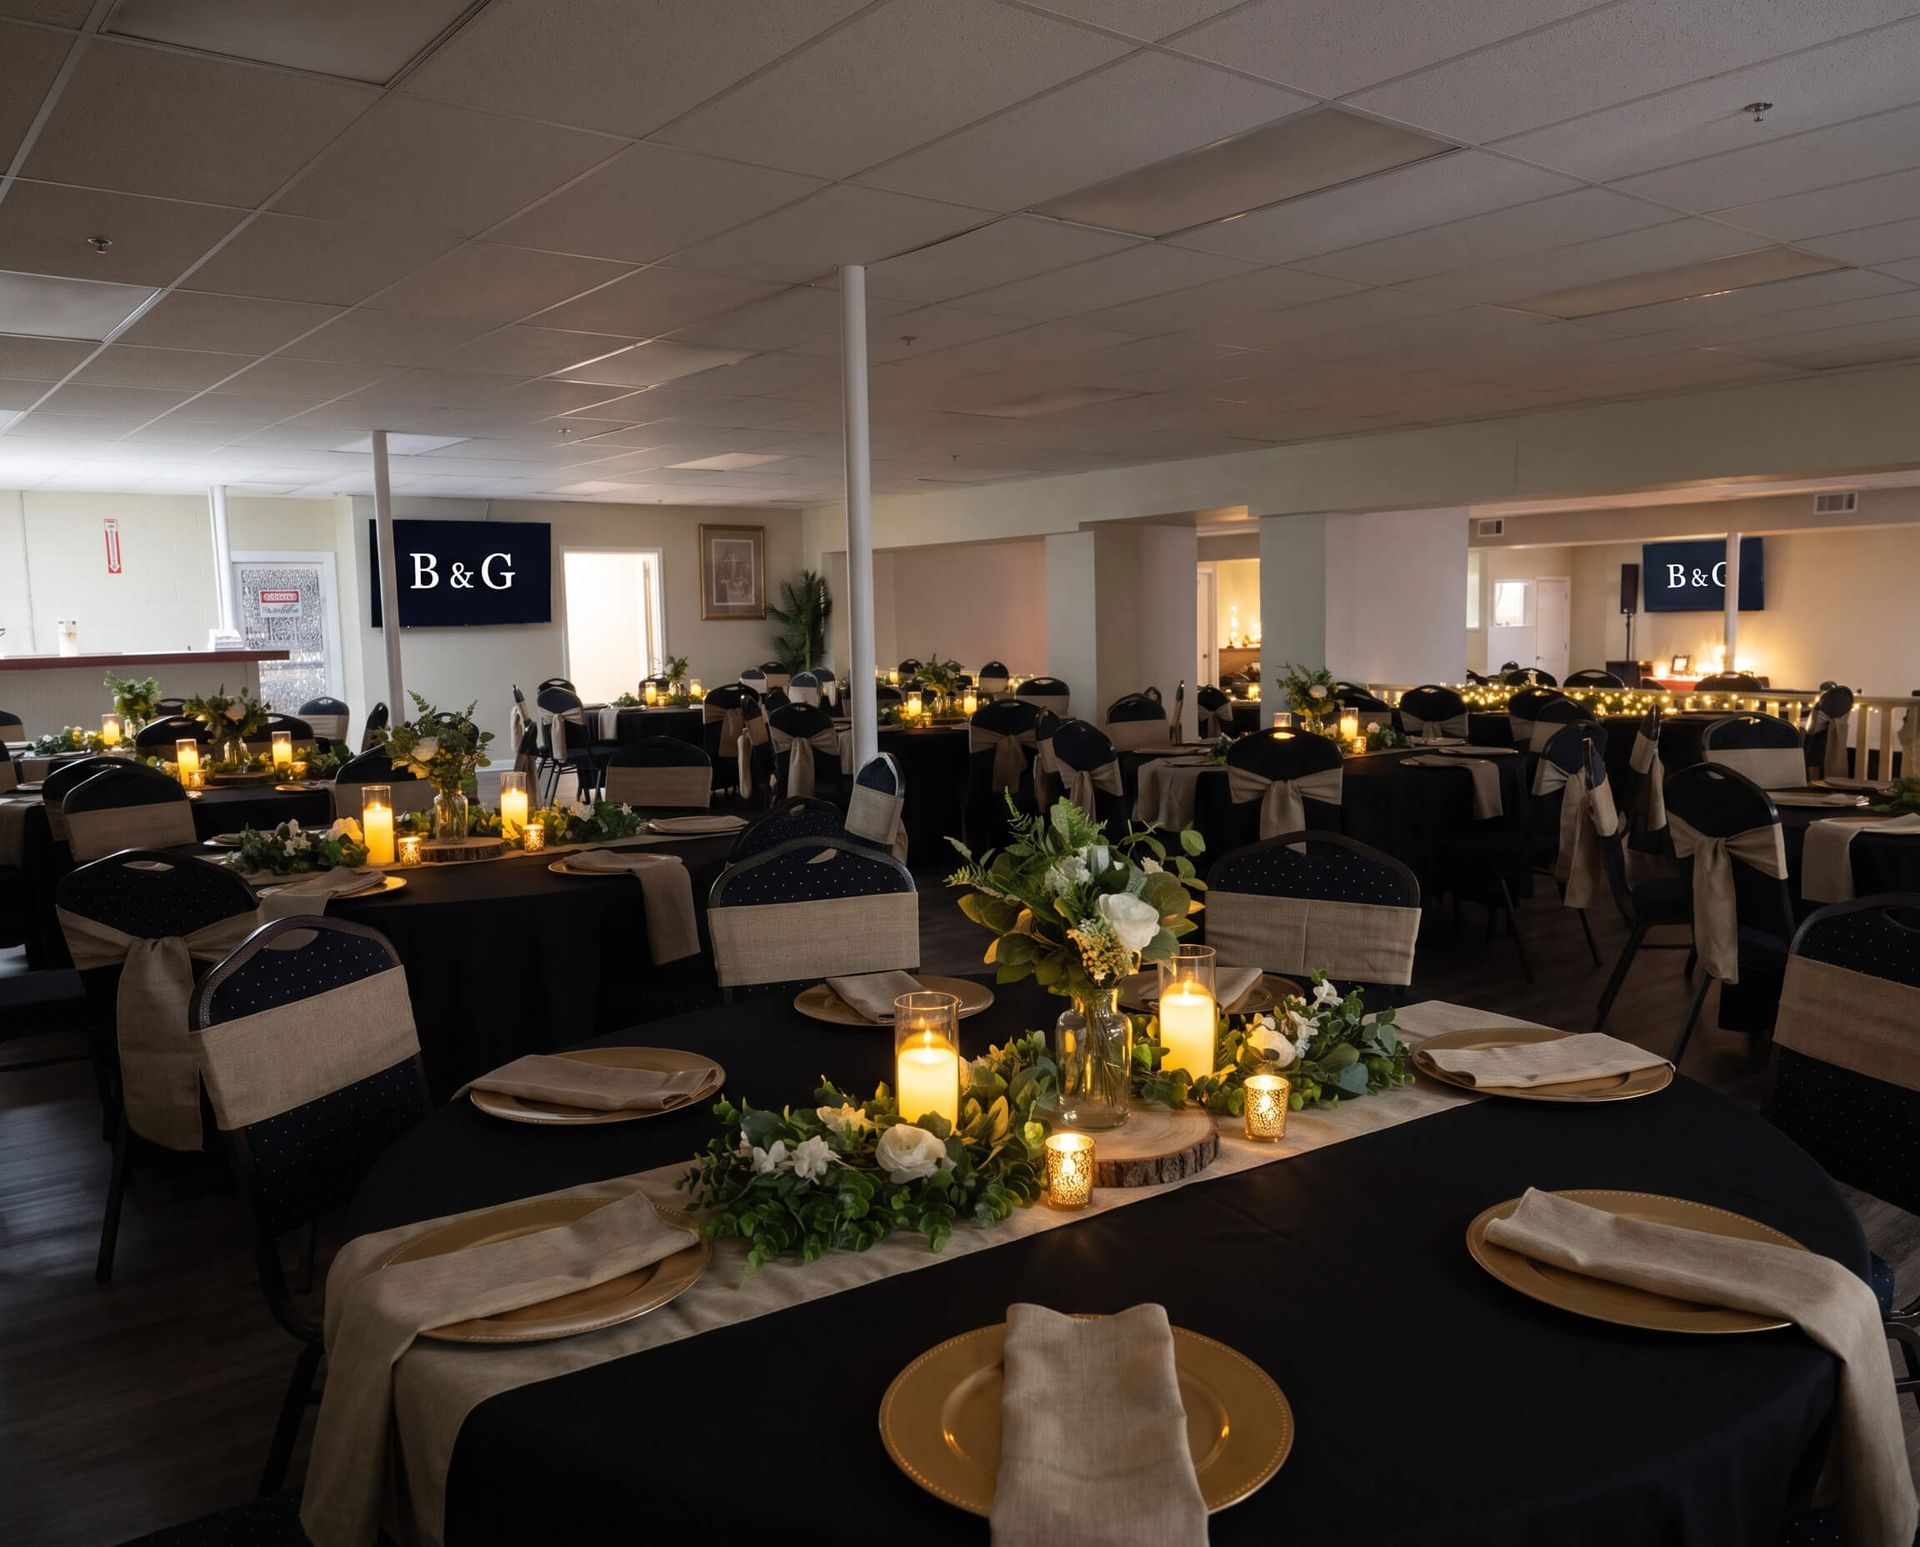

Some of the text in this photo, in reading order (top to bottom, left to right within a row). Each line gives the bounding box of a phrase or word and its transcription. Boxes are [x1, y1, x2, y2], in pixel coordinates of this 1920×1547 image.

[409, 552, 516, 590] B & G
[1666, 563, 1687, 589] B
[1691, 567, 1709, 588] &
